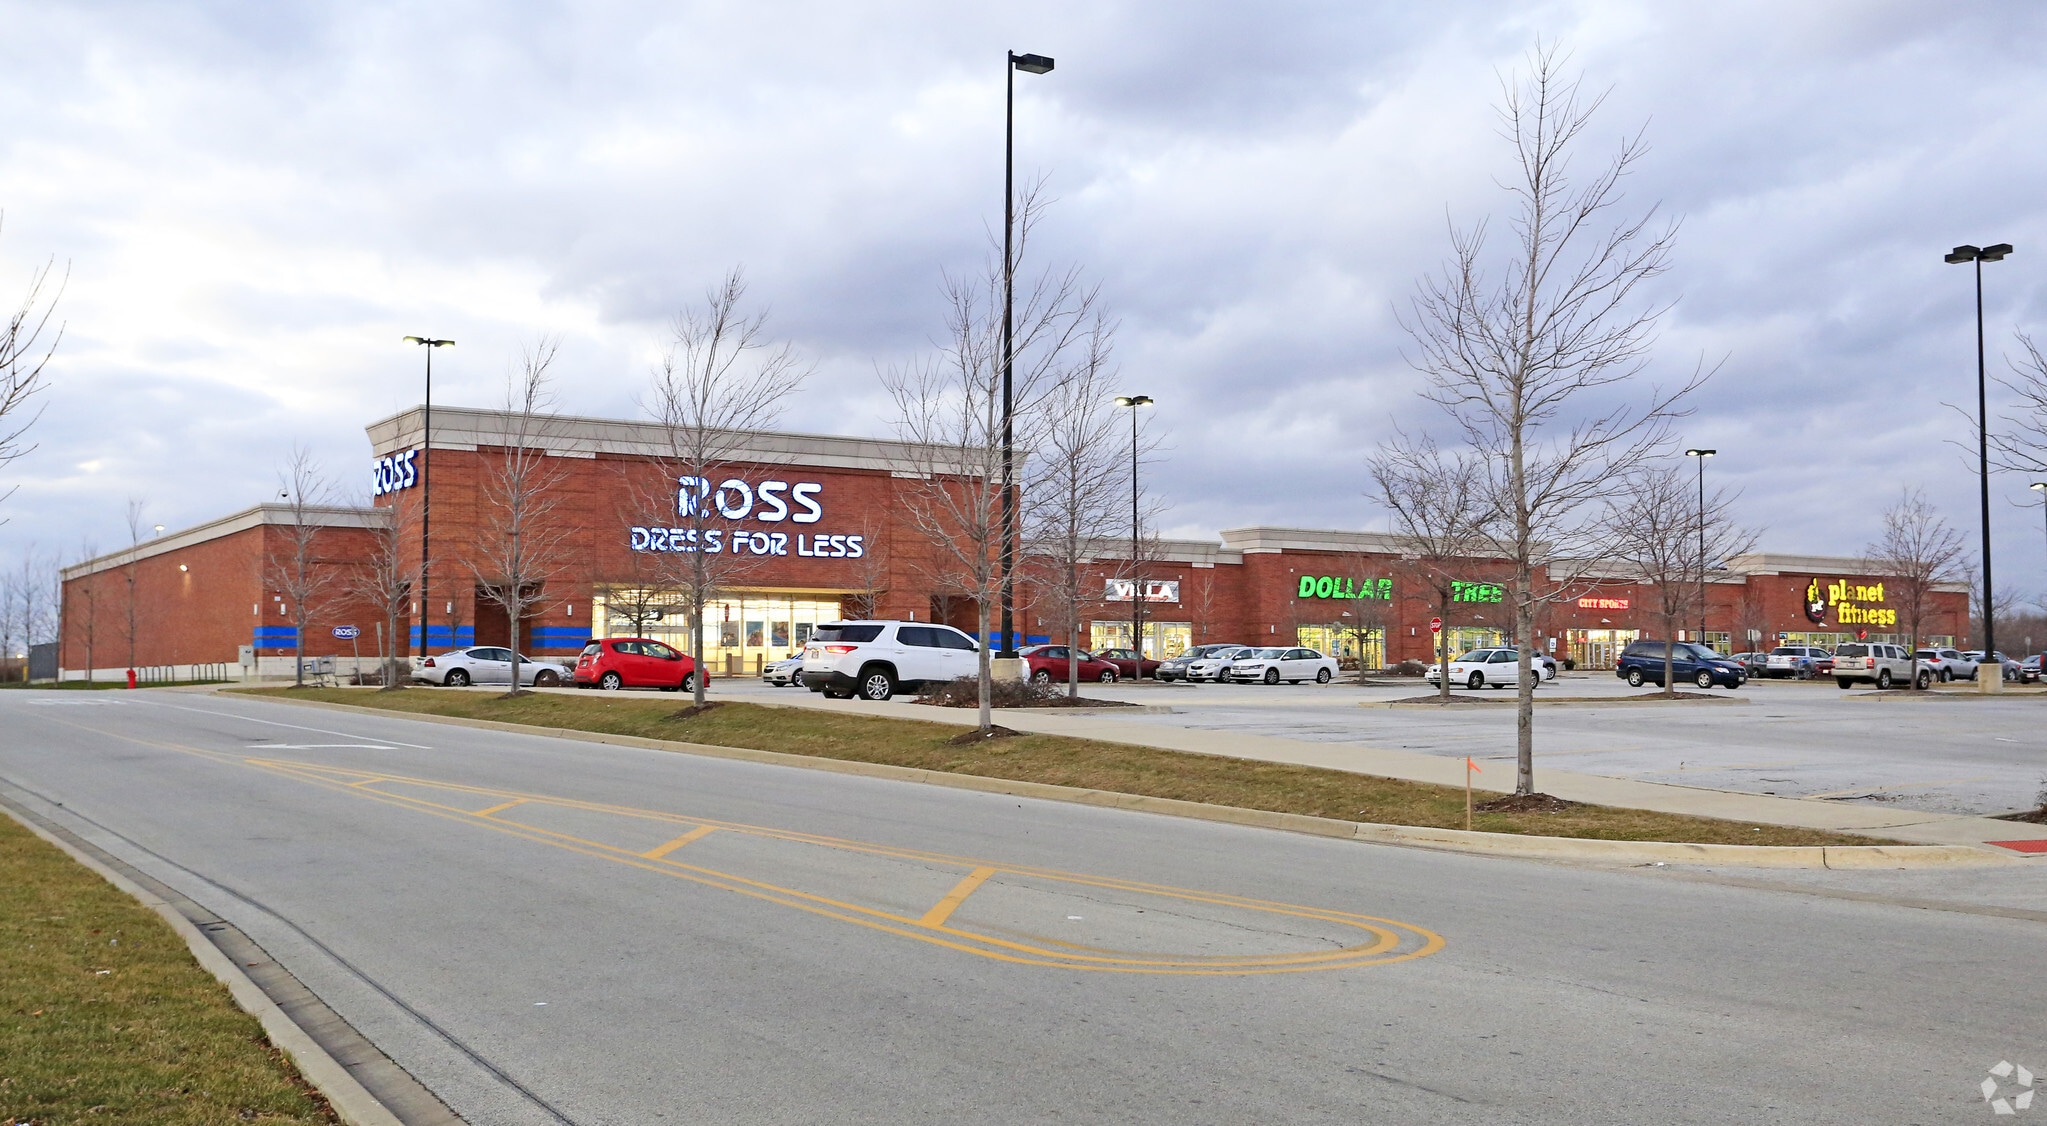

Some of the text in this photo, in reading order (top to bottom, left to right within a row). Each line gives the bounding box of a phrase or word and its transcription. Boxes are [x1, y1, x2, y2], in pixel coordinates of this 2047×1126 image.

[373, 450, 418, 495] ROSS
[678, 475, 822, 523] ROSS
[631, 526, 863, 558] DRESS FOR LESS
[1299, 575, 1504, 603] DOLLAR TREE
[1828, 579, 1884, 606] planet
[1579, 598, 1629, 609] CITY SPORTS
[1838, 602, 1896, 625] fitness
